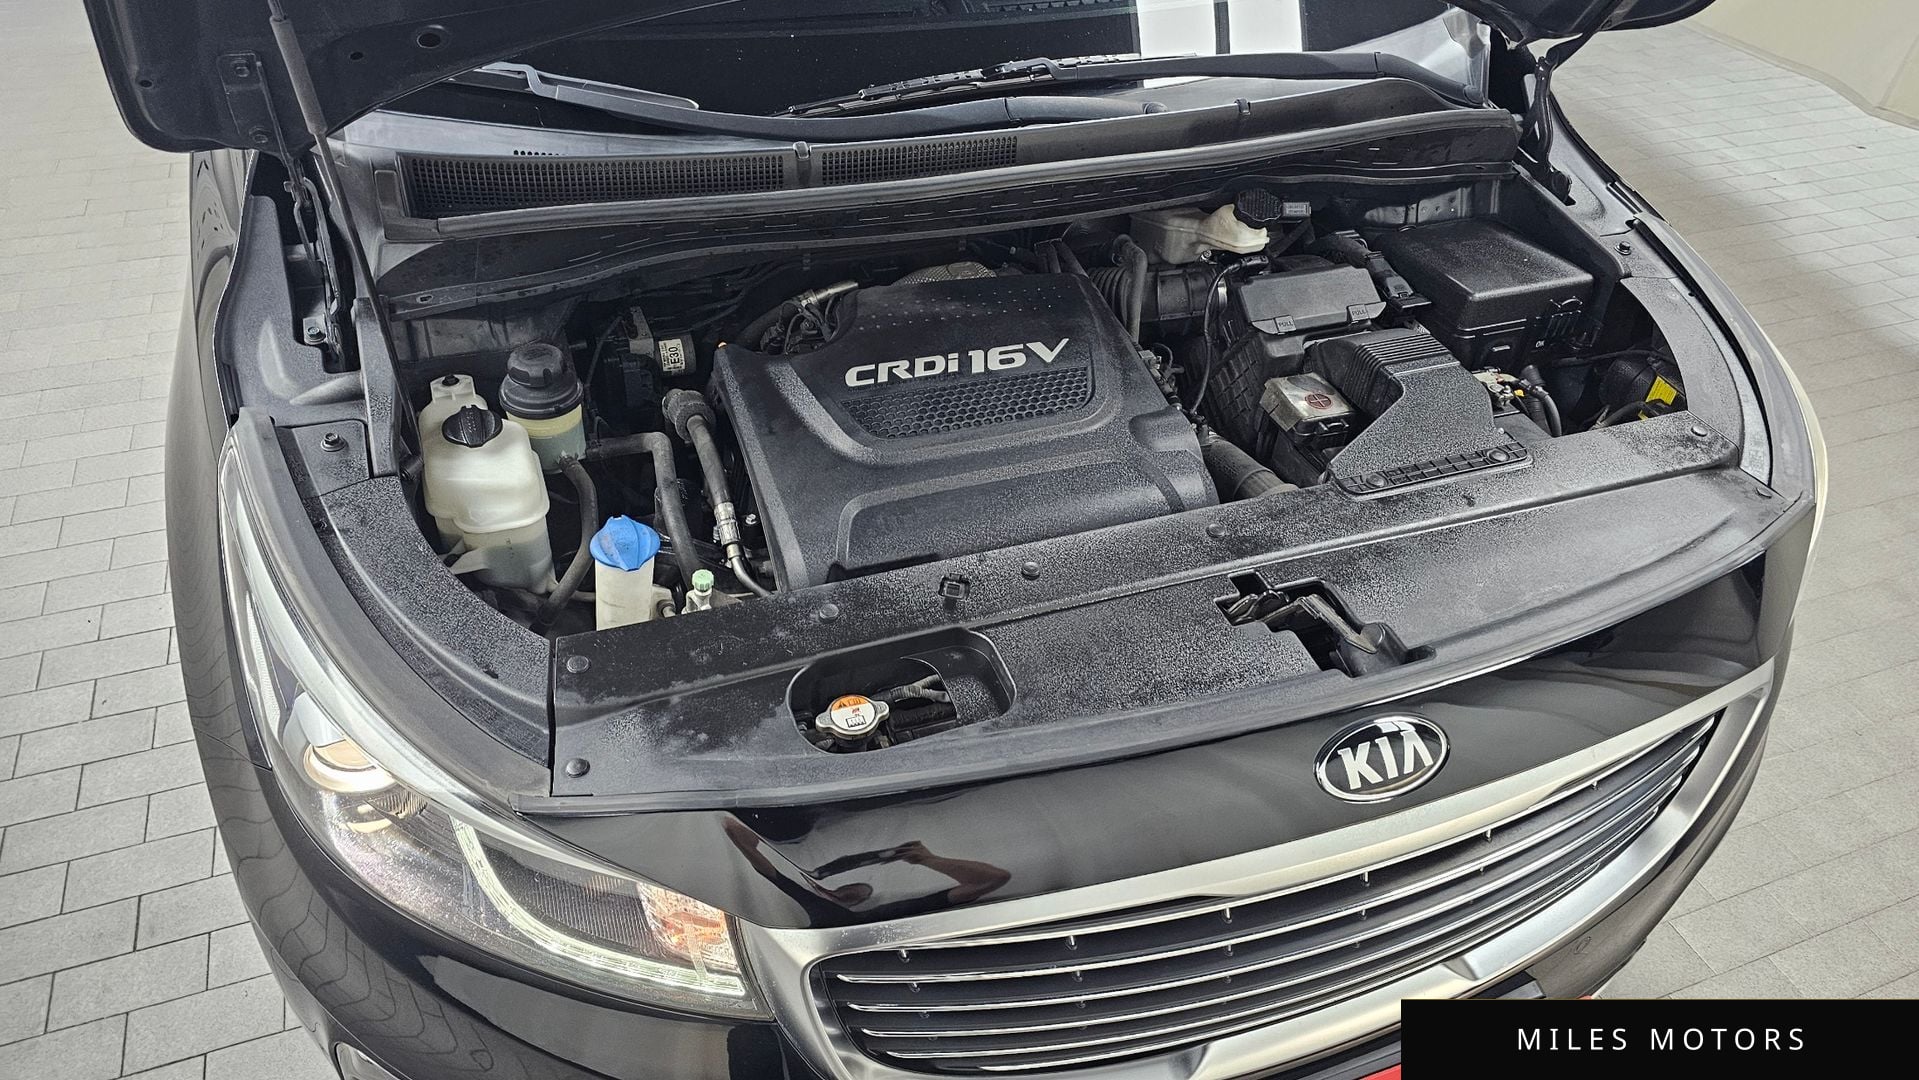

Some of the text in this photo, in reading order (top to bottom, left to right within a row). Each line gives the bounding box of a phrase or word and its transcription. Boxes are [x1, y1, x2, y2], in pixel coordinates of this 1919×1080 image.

[668, 346, 680, 365] E30
[844, 337, 1070, 388] CRDi 16V
[1337, 730, 1434, 790] KIA
